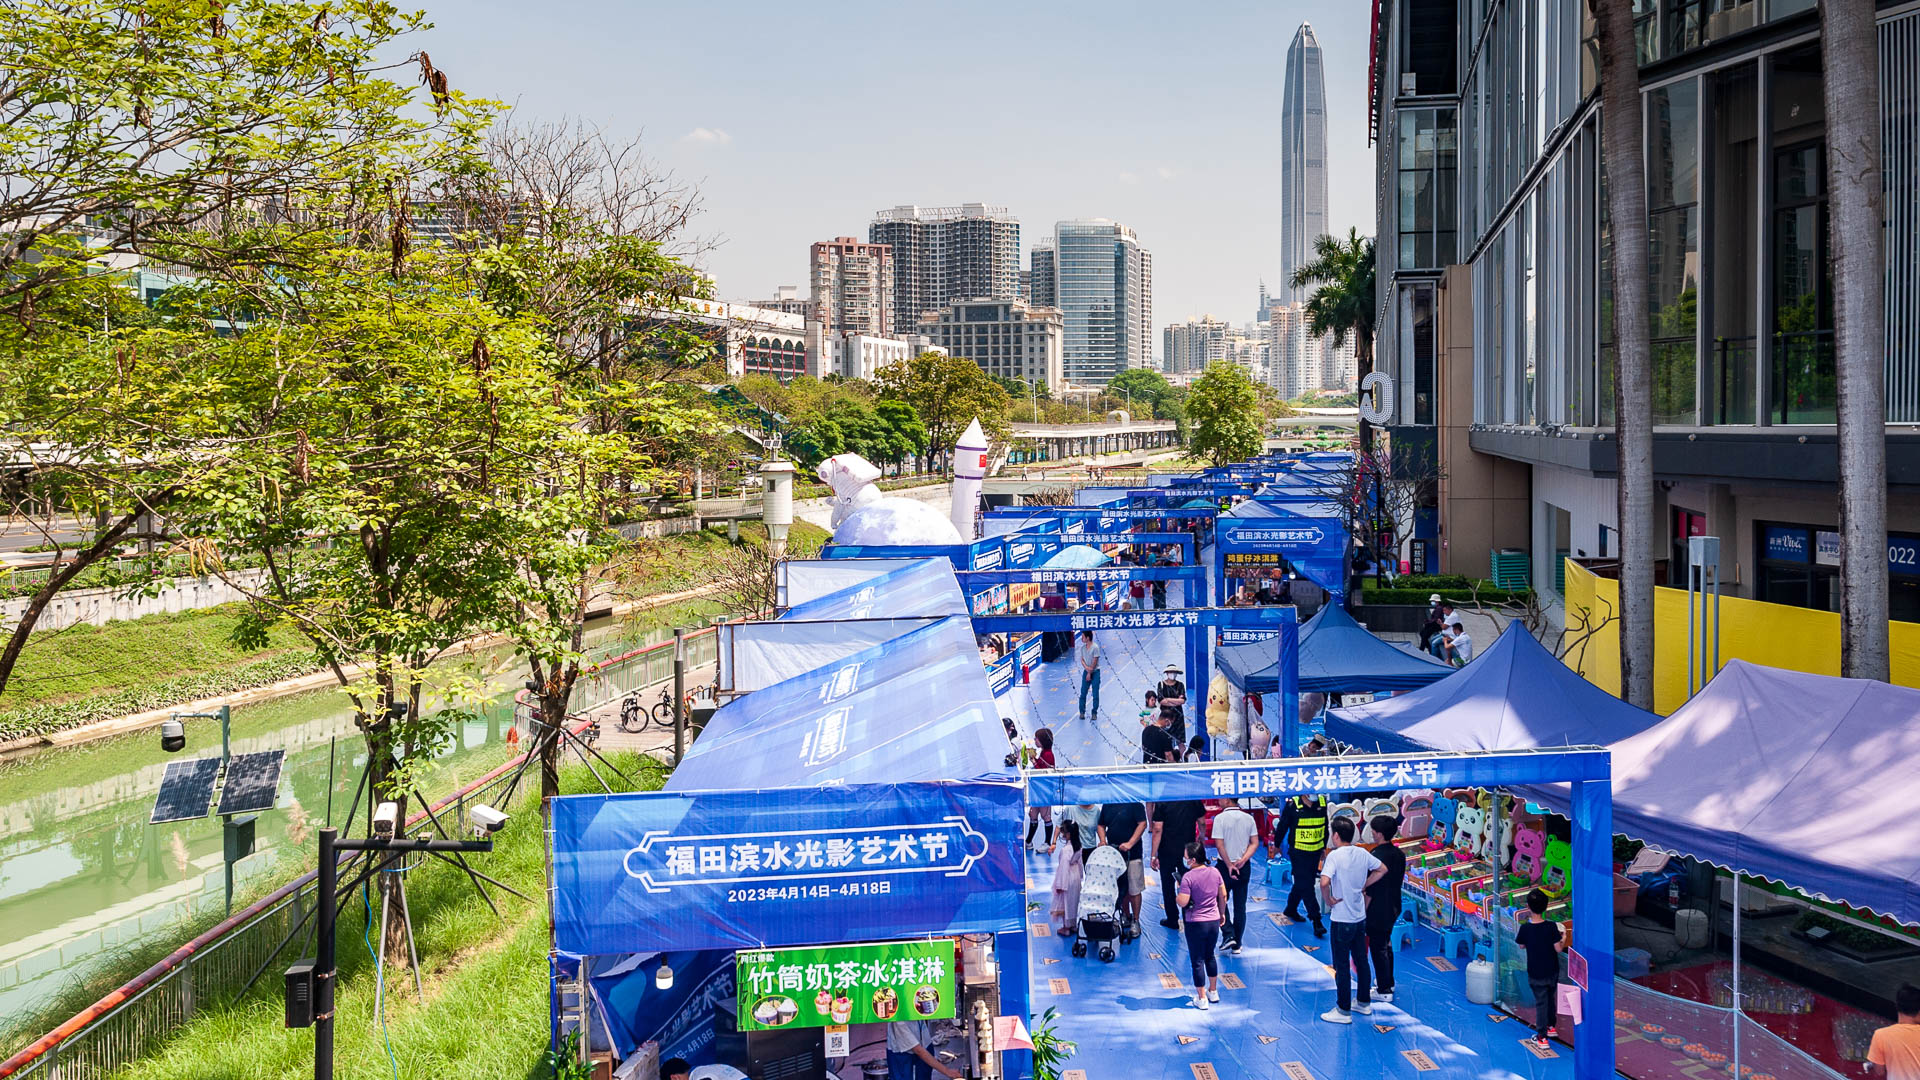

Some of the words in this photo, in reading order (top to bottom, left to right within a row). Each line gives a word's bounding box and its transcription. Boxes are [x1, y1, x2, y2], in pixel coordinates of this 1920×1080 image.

[1060, 534, 1135, 543] 福田滨水光影艺术节
[1236, 531, 1314, 540] 福田滨水光影艺术节
[1031, 570, 1131, 582] 福田滨水光影艺术节
[1070, 612, 1198, 630] 福田滨水光影艺术节
[1211, 762, 1439, 795] 福田滨水光影艺术节
[665, 832, 950, 876] 福田滨水光影艺术节
[727, 881, 891, 902] 2023年4月14日-4月18日
[747, 956, 945, 994] 竹筒奶茶冰淇淋
